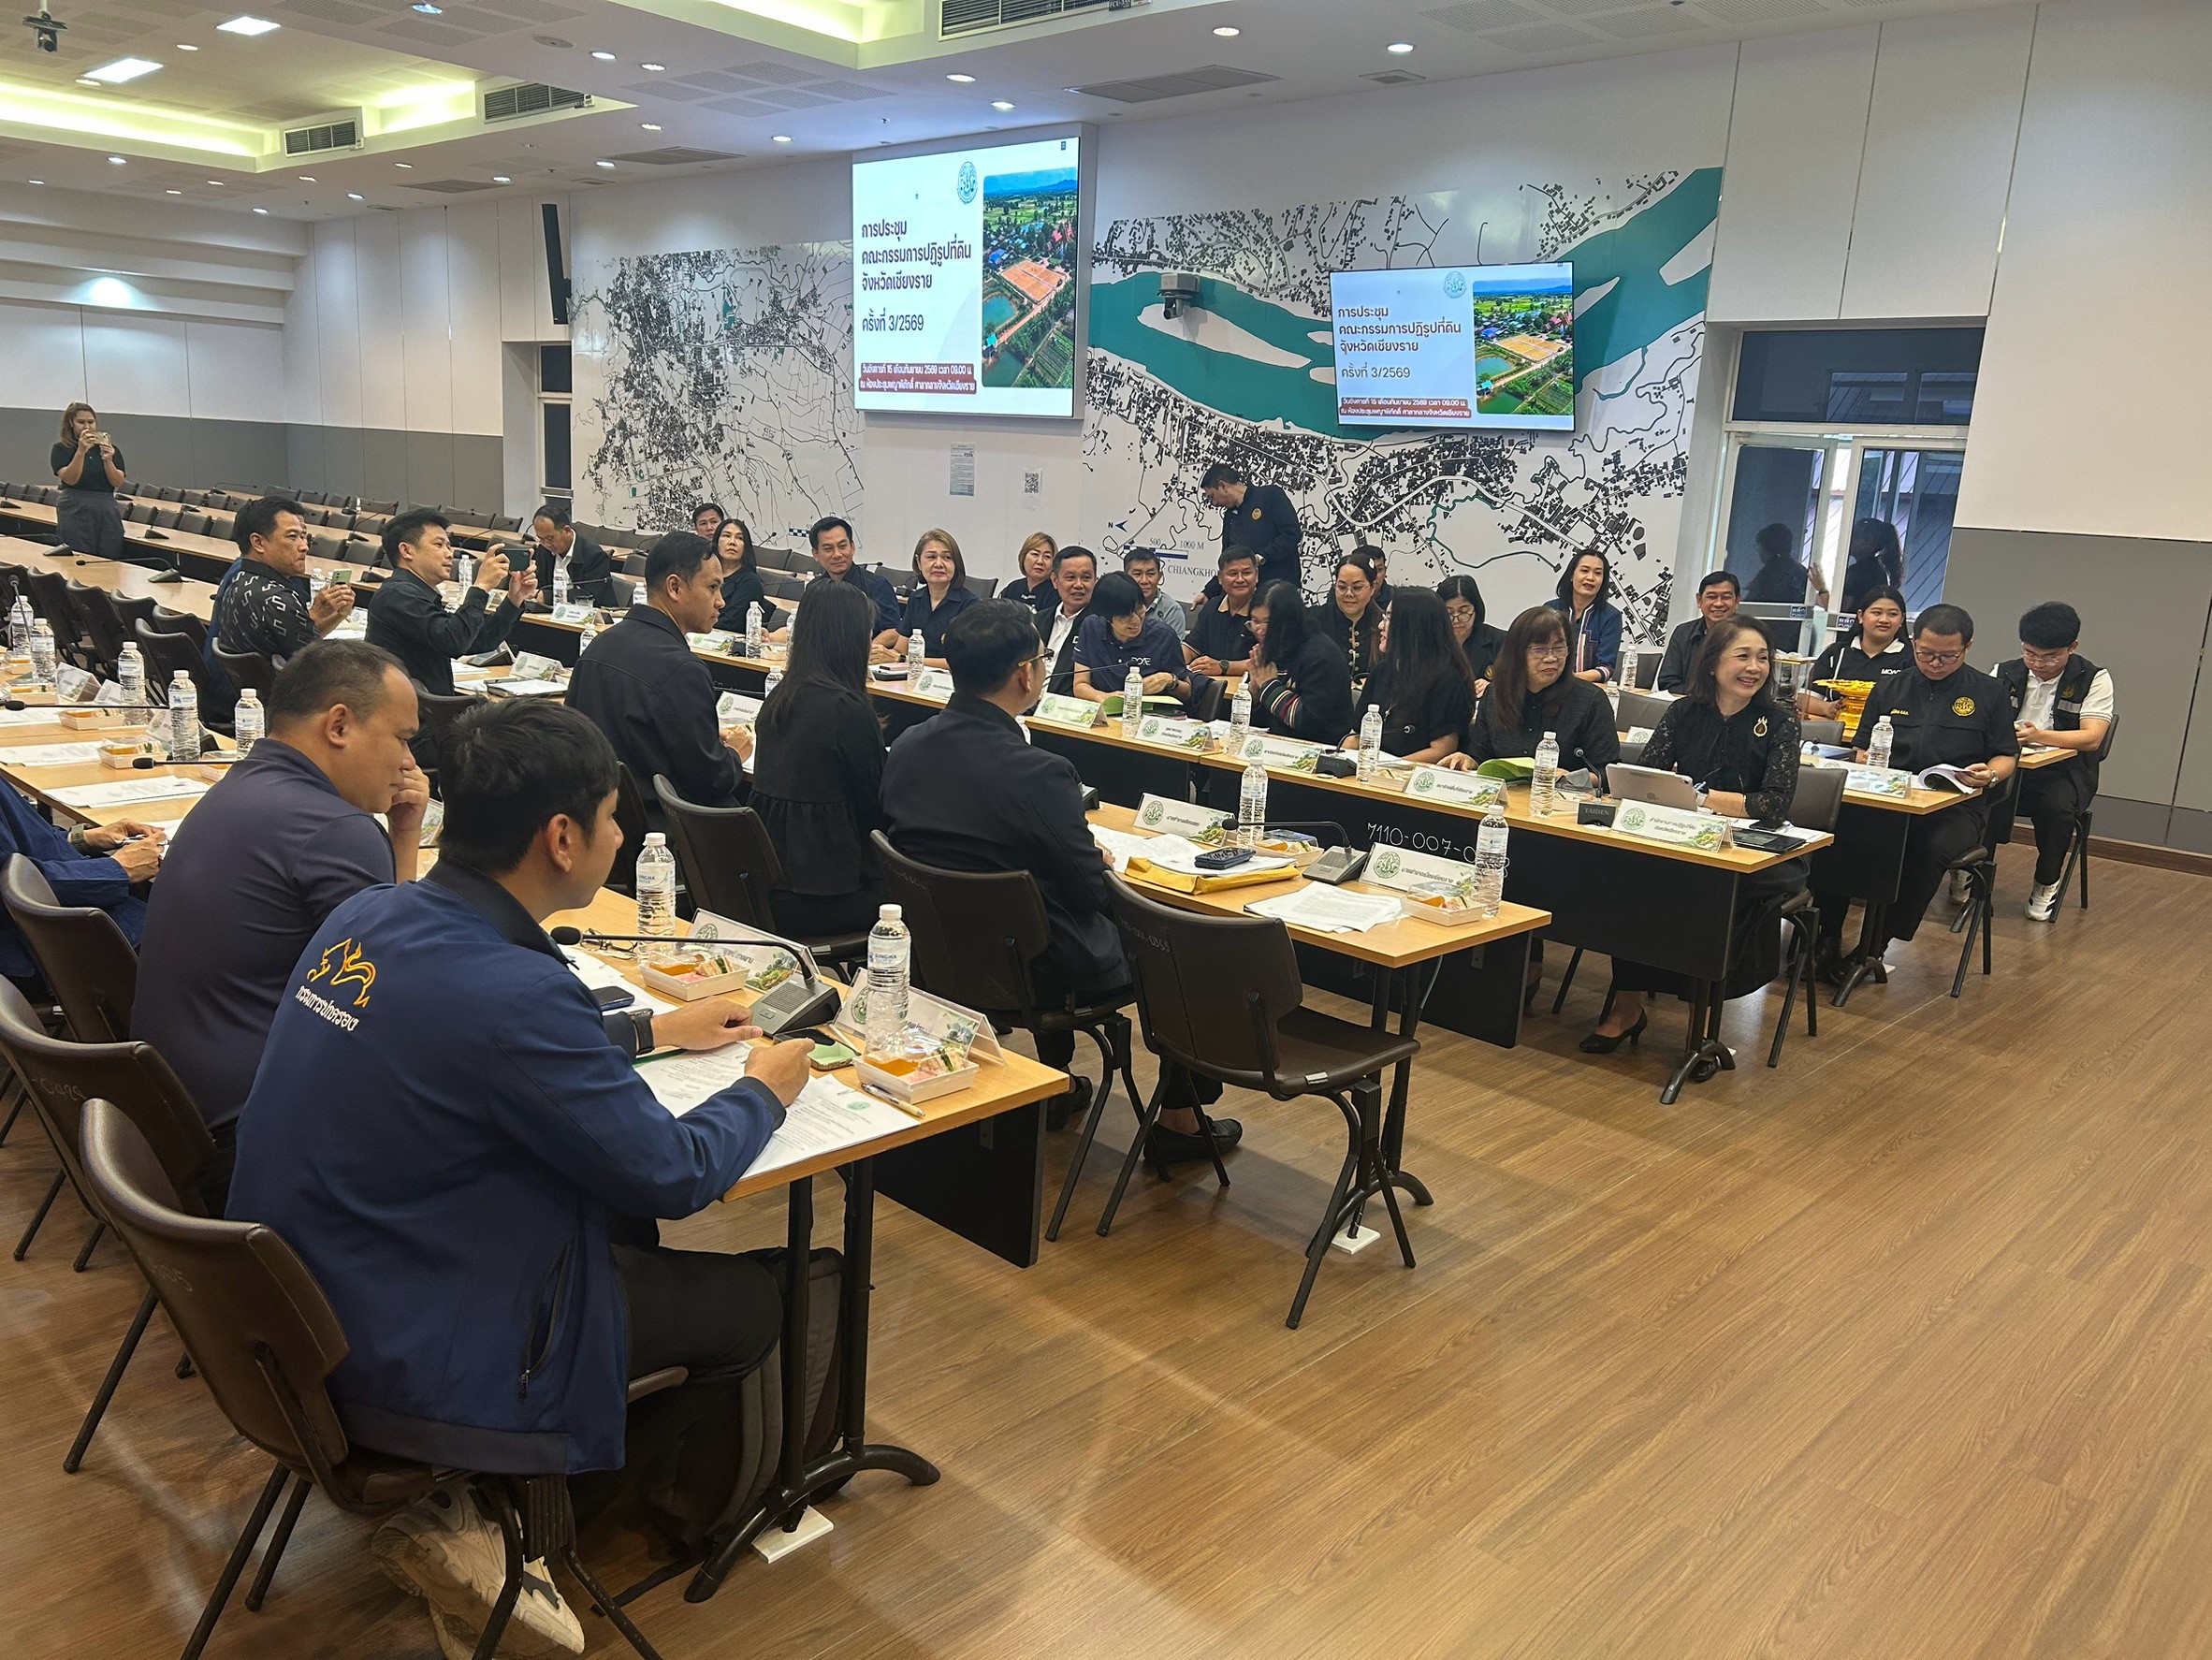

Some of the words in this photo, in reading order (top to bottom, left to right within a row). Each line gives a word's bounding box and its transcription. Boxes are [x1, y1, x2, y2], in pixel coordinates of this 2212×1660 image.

[862, 219, 908, 242] การประชุม
[862, 234, 971, 268] คณะกรรมการปฏิรูปที่ดิน
[862, 269, 933, 291] จังหวัดเชียงราย
[862, 308, 886, 331] ครั้งที่
[888, 314, 924, 331] 3/2569
[1338, 305, 1389, 321] การประชุม
[1339, 316, 1462, 338] คณะกรรมการปฏิรูปที่ดิน
[1340, 339, 1419, 355] จังหวัดเชียงราย
[1341, 362, 1368, 378] ครั้งที่
[1371, 367, 1411, 378] 3/2569
[1149, 537, 1160, 546] 500
[1180, 540, 1196, 548] 1000
[1168, 564, 1217, 577] CHIANGKHO
[1584, 807, 1610, 816] TAIDEN
[1367, 822, 1510, 879] 7110-007-0
